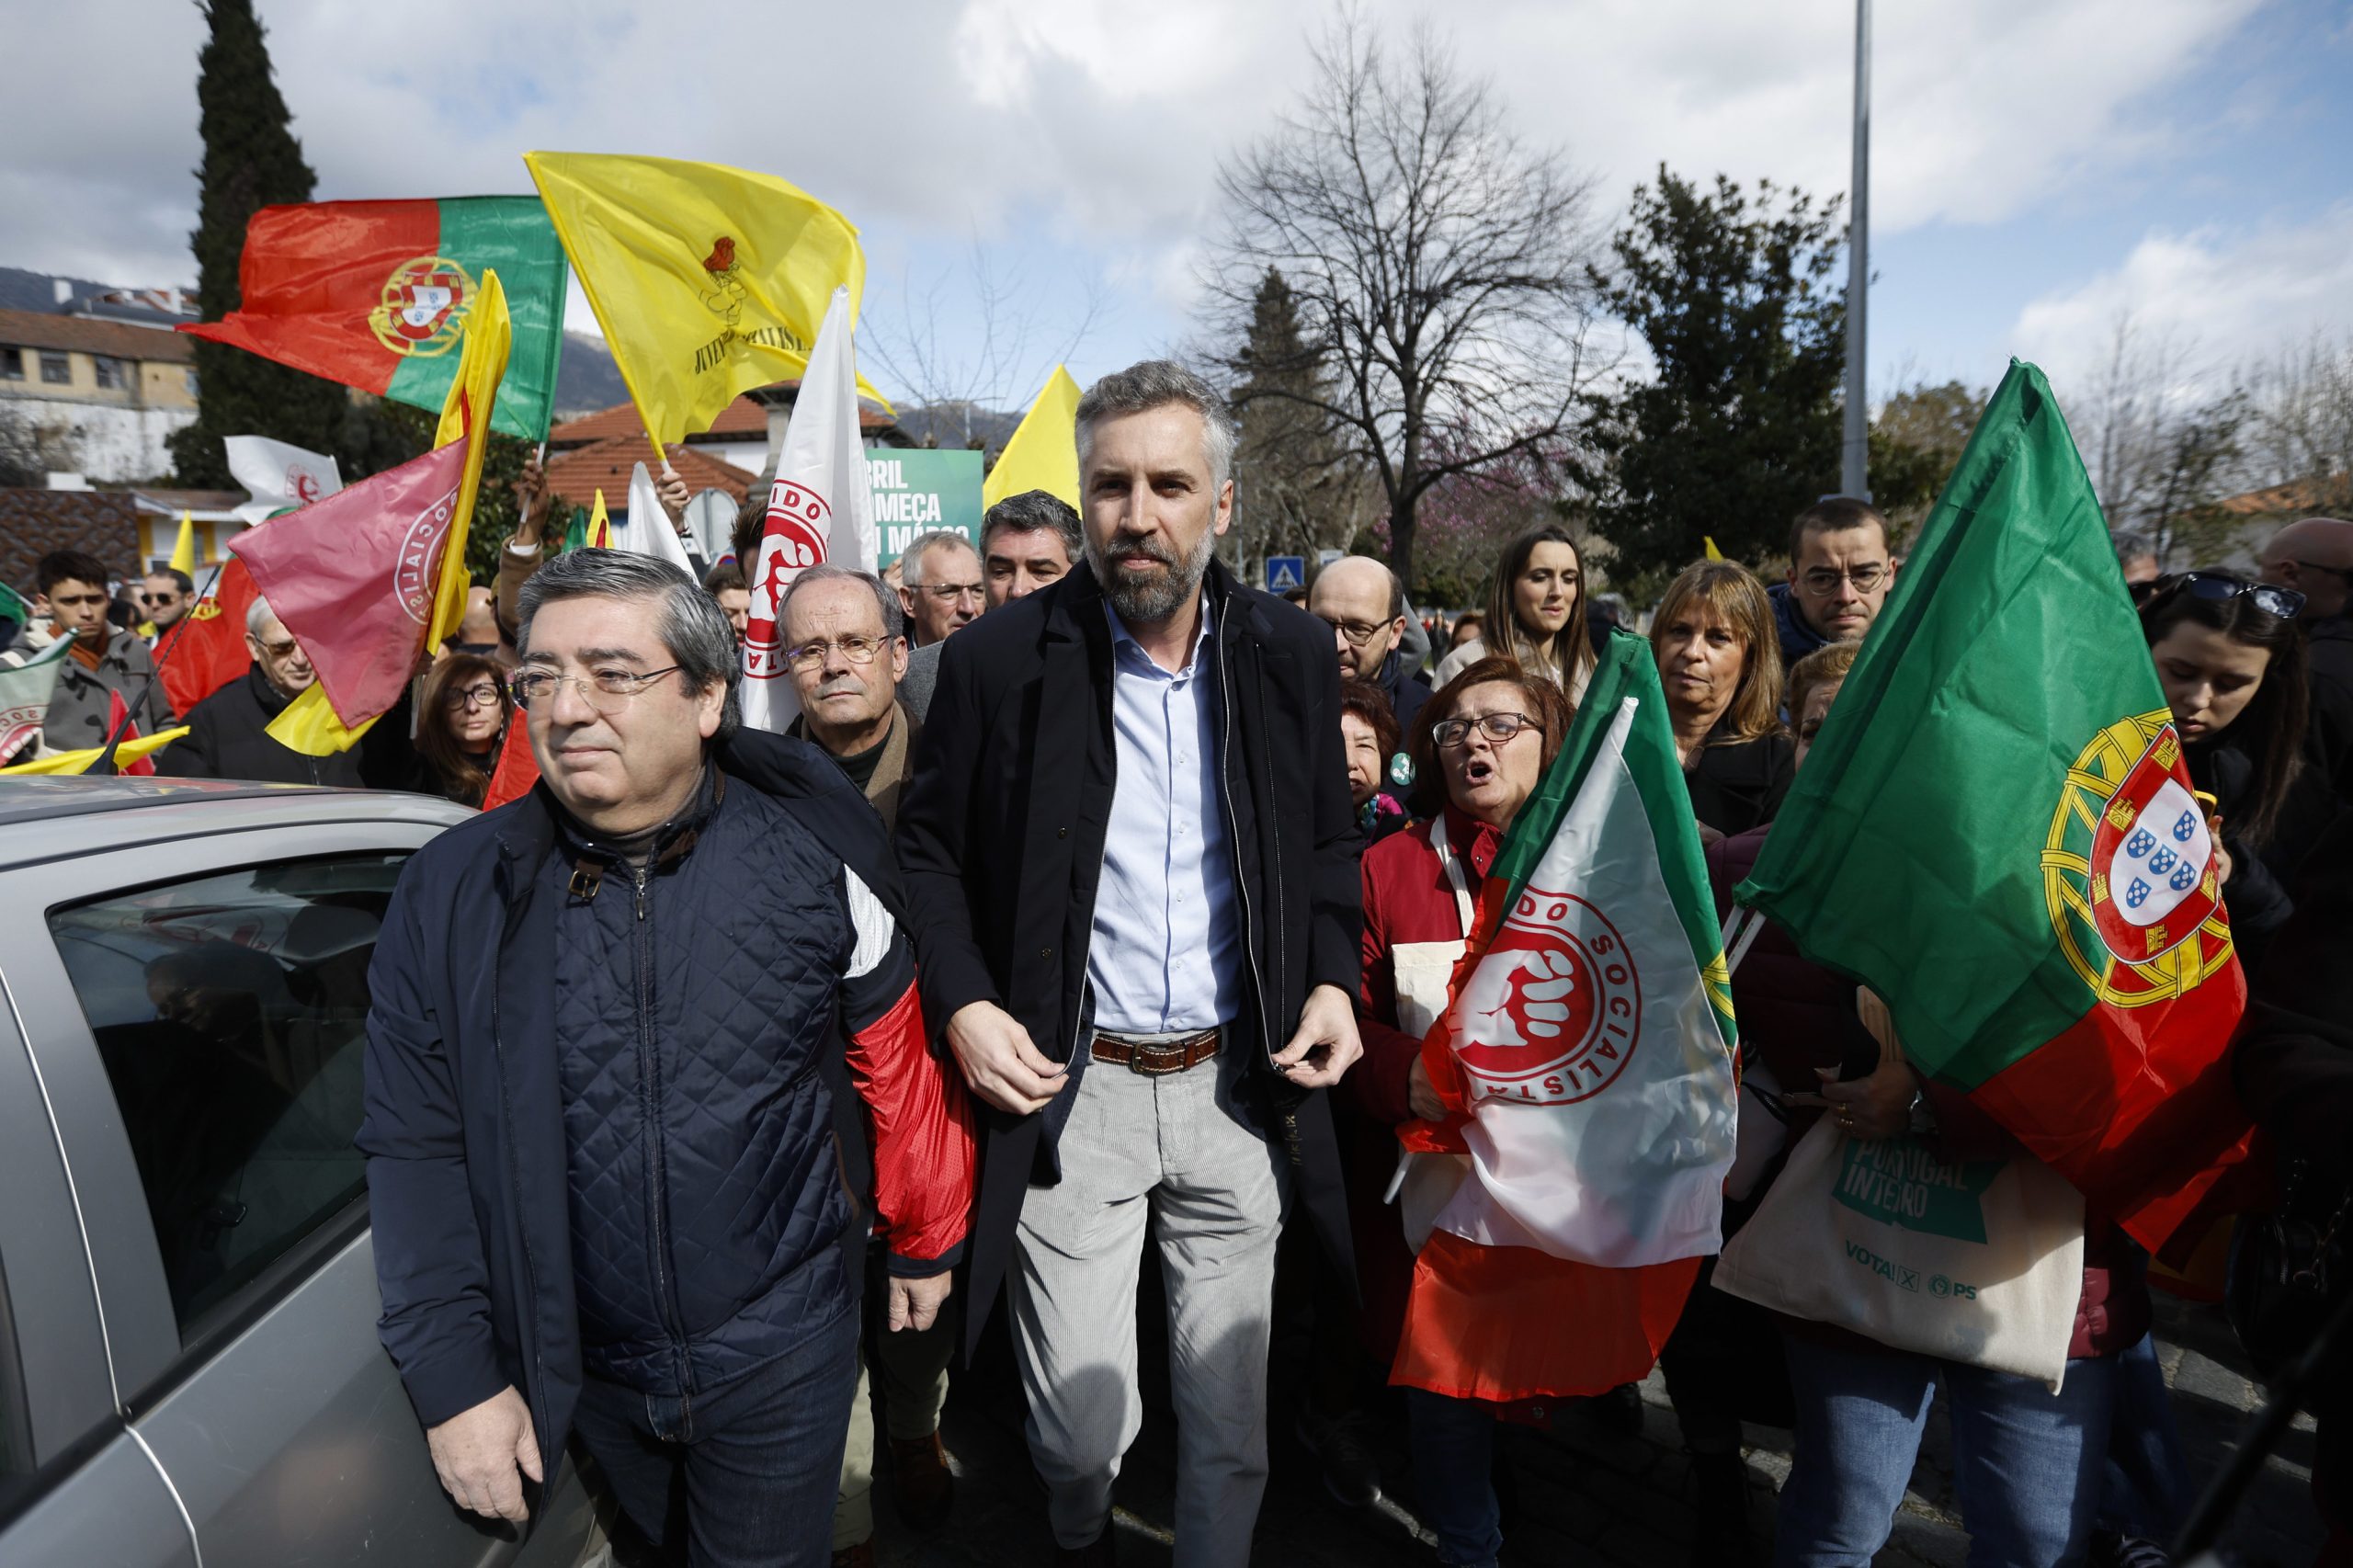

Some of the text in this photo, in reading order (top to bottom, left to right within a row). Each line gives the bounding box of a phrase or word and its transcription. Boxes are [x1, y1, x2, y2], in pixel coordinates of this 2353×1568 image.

[866, 460, 908, 489] BRIL
[771, 487, 821, 520] IDO
[872, 493, 941, 527] MEÇA
[1486, 935, 1631, 1099] SOCIALISTA
[1846, 1240, 1895, 1281] VOTA!
[1953, 1282, 1978, 1300] PS
